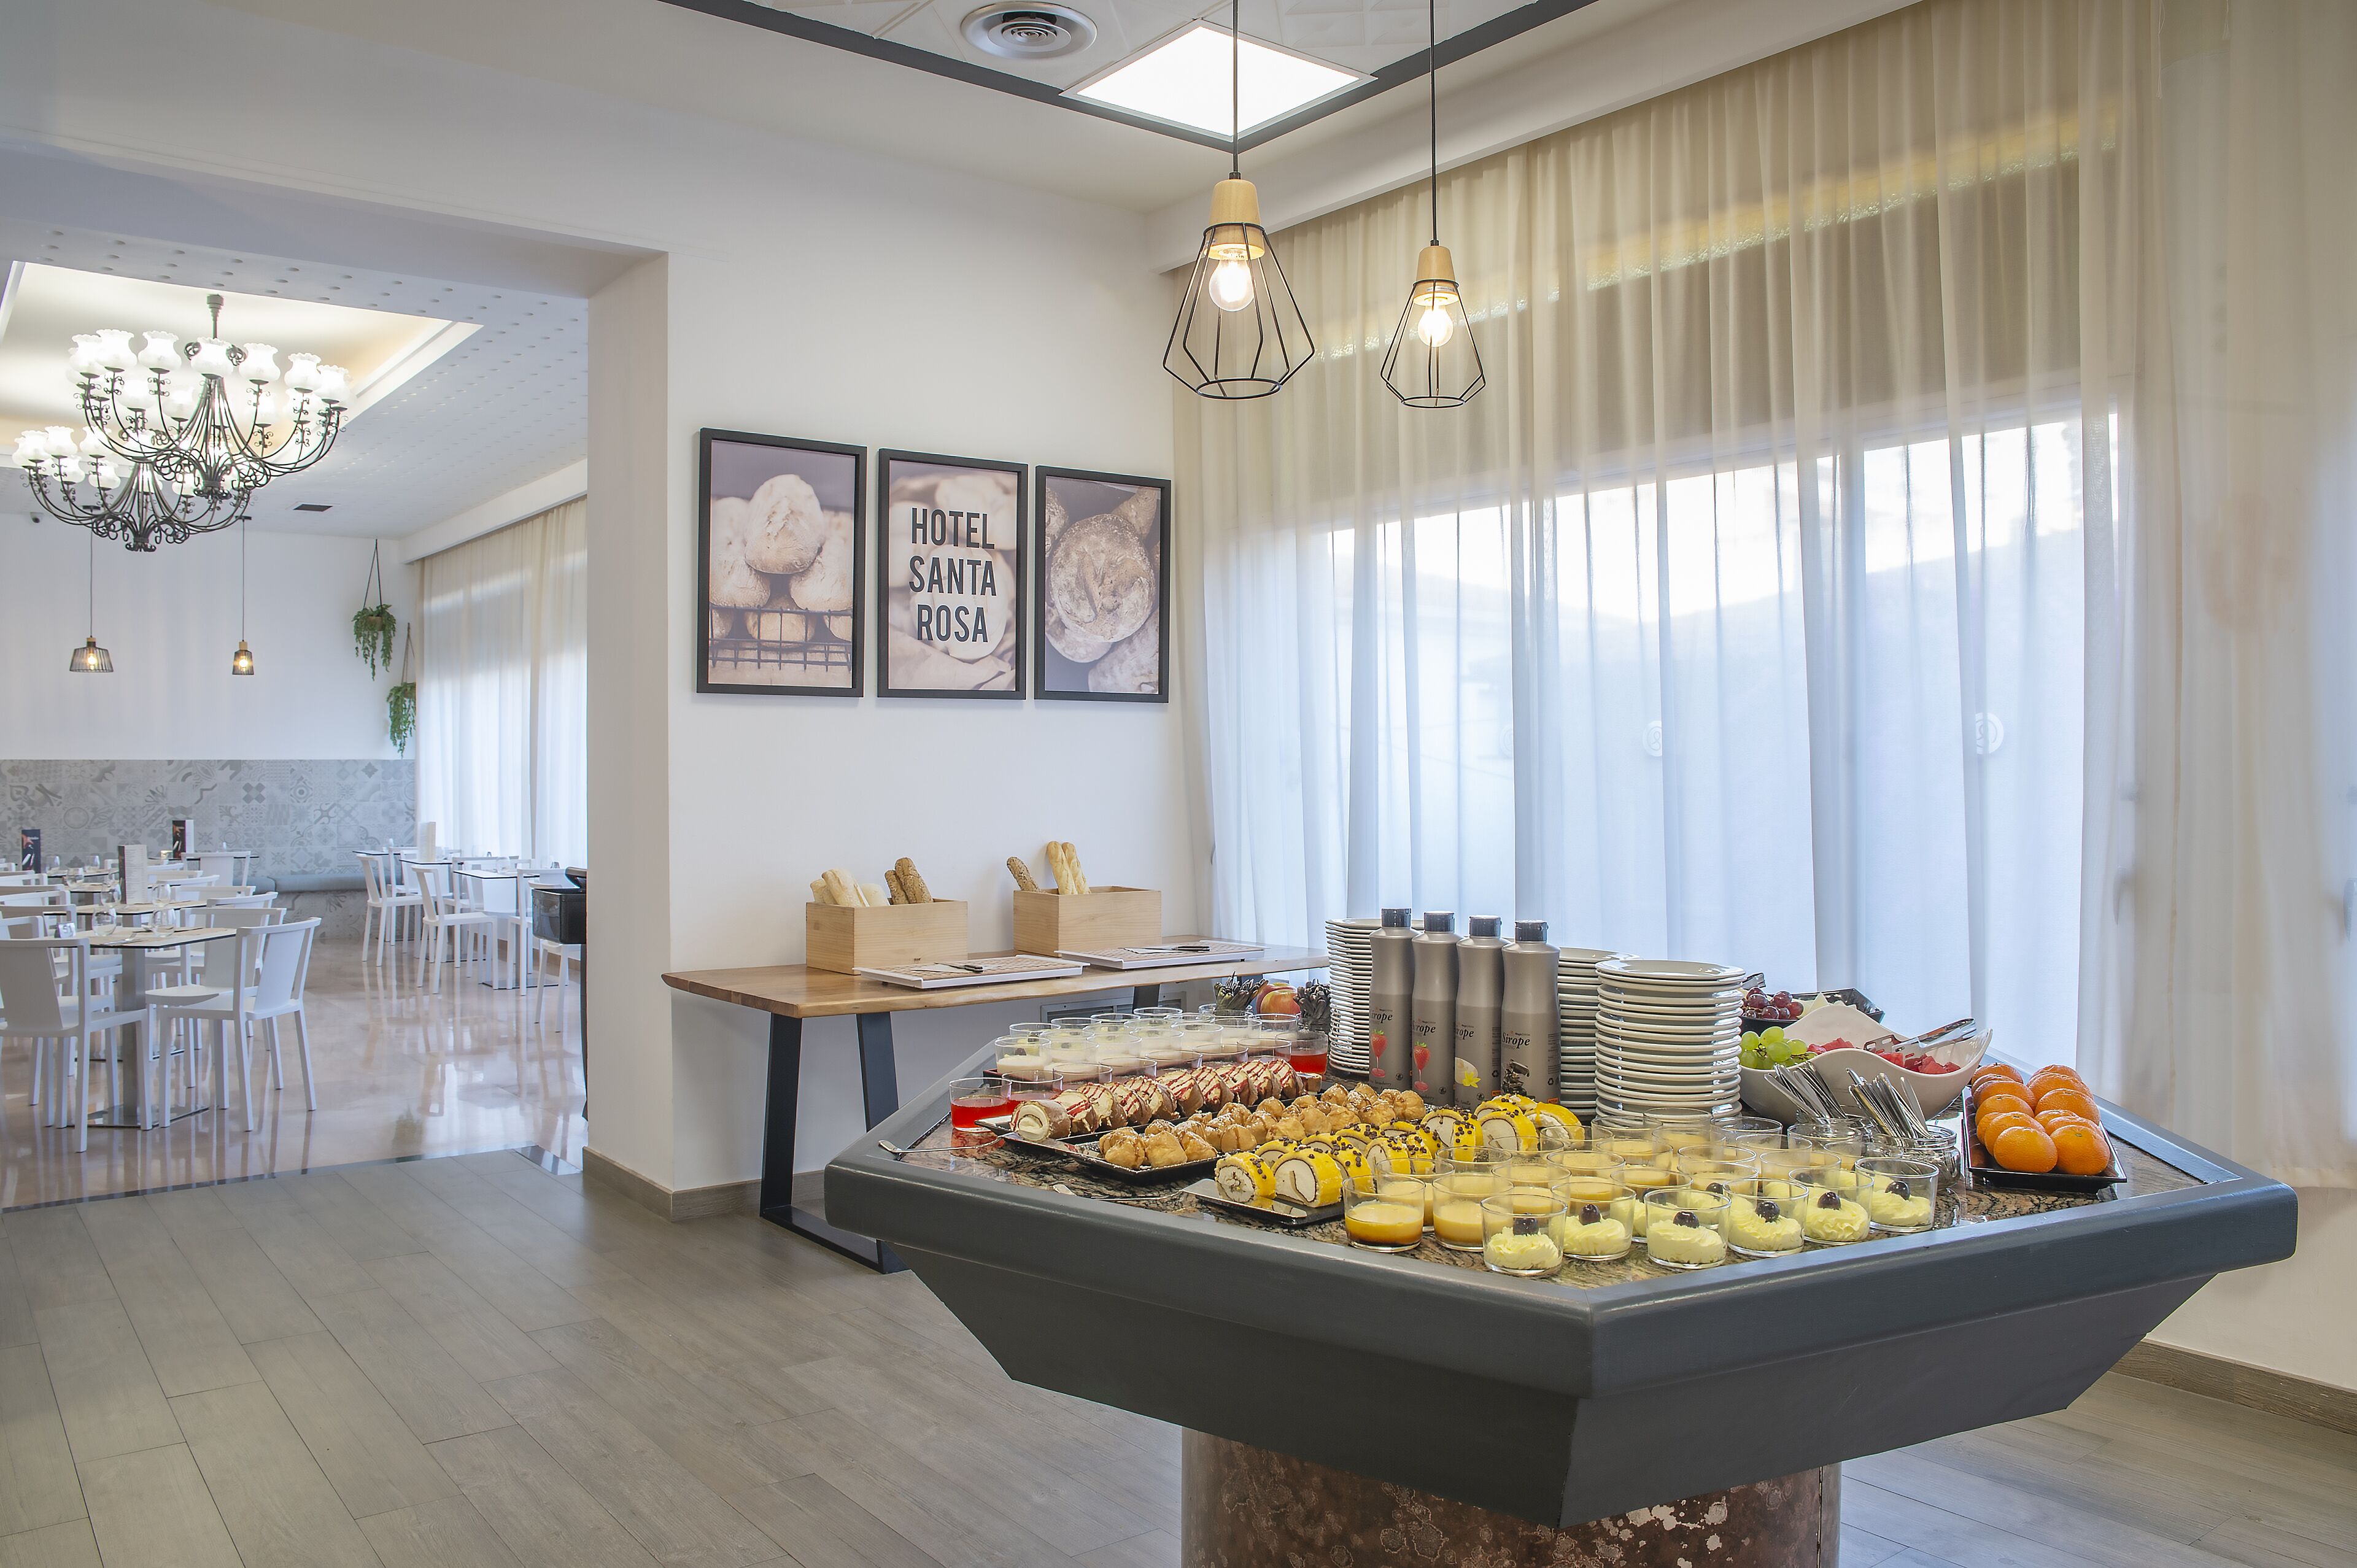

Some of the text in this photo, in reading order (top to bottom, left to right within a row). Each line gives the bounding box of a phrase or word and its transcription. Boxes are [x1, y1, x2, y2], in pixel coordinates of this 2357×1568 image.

[911, 507, 996, 550] HOTEL
[908, 555, 997, 597] SANTA
[917, 604, 989, 643] ROSA
[1371, 1010, 1393, 1024] irope
[1456, 1028, 1474, 1040] rope
[1503, 1032, 1530, 1049] Sirope
